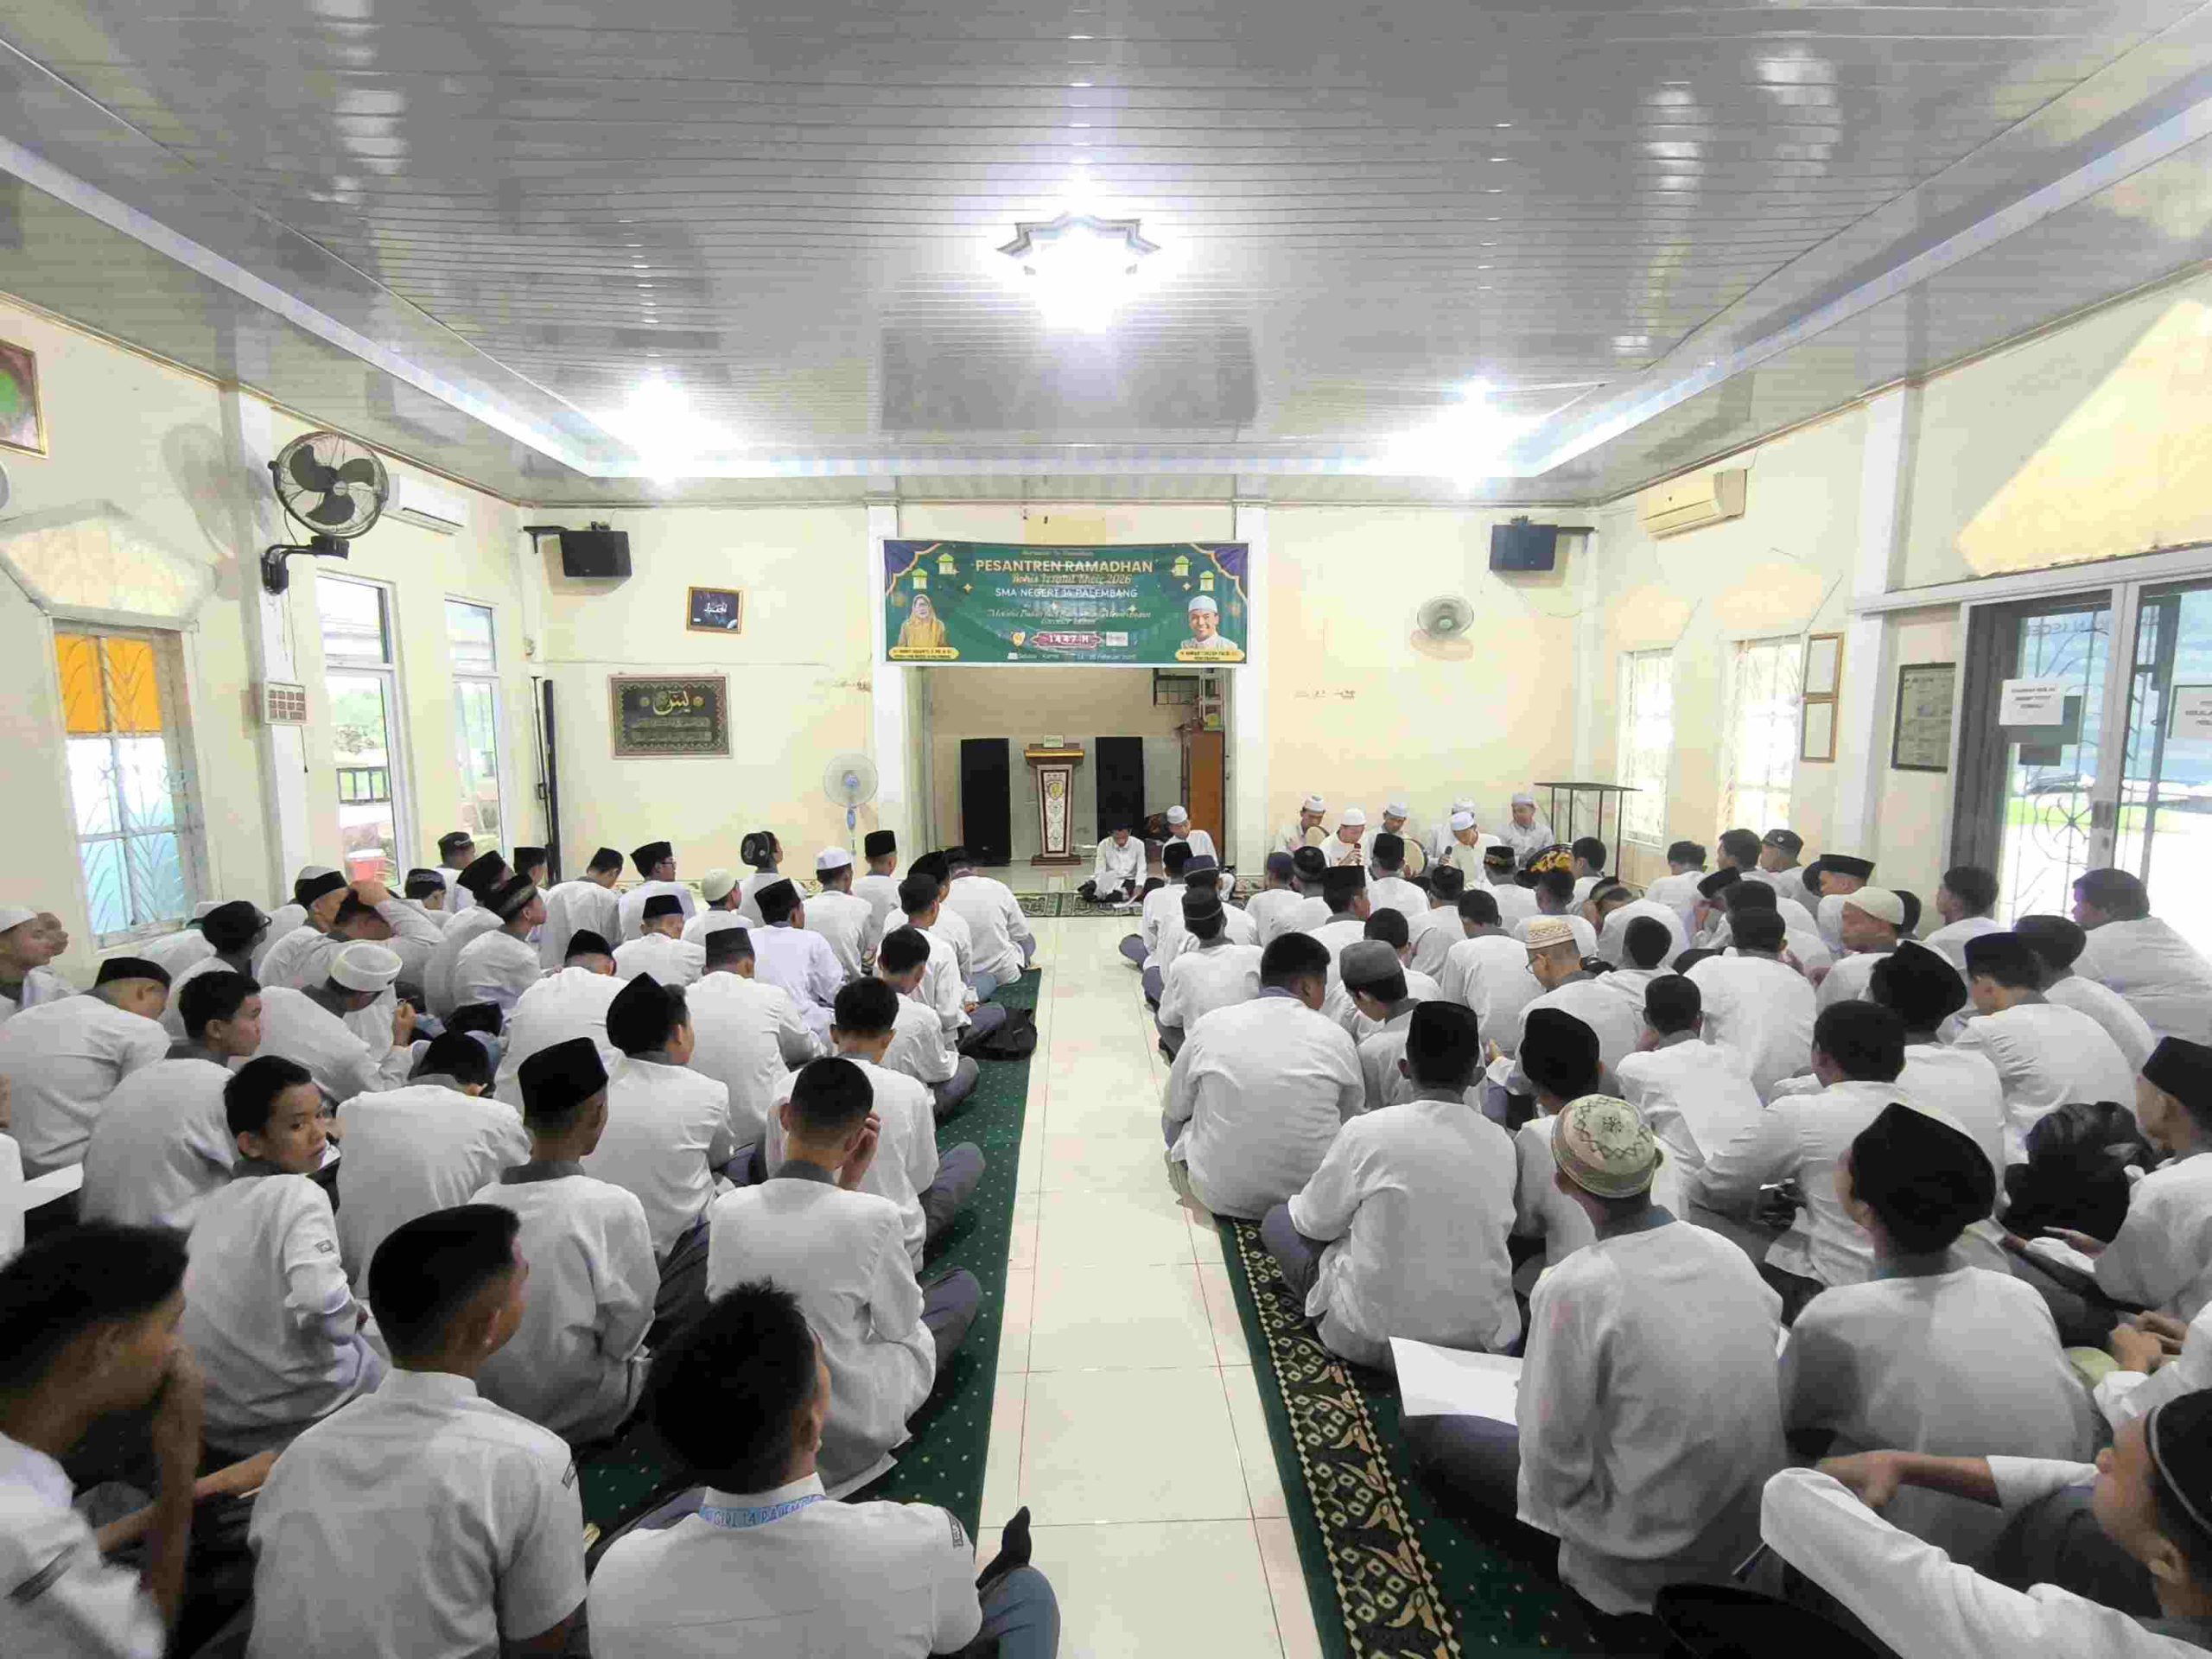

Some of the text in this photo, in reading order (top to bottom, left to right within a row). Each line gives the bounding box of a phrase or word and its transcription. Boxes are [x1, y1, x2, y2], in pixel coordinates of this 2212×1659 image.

[976, 559, 1153, 573] PESANTREN RAMADHAN
[995, 588, 1017, 598] SMA
[1020, 588, 1058, 599] NEGERI
[1075, 588, 1139, 599] PALEMBANG
